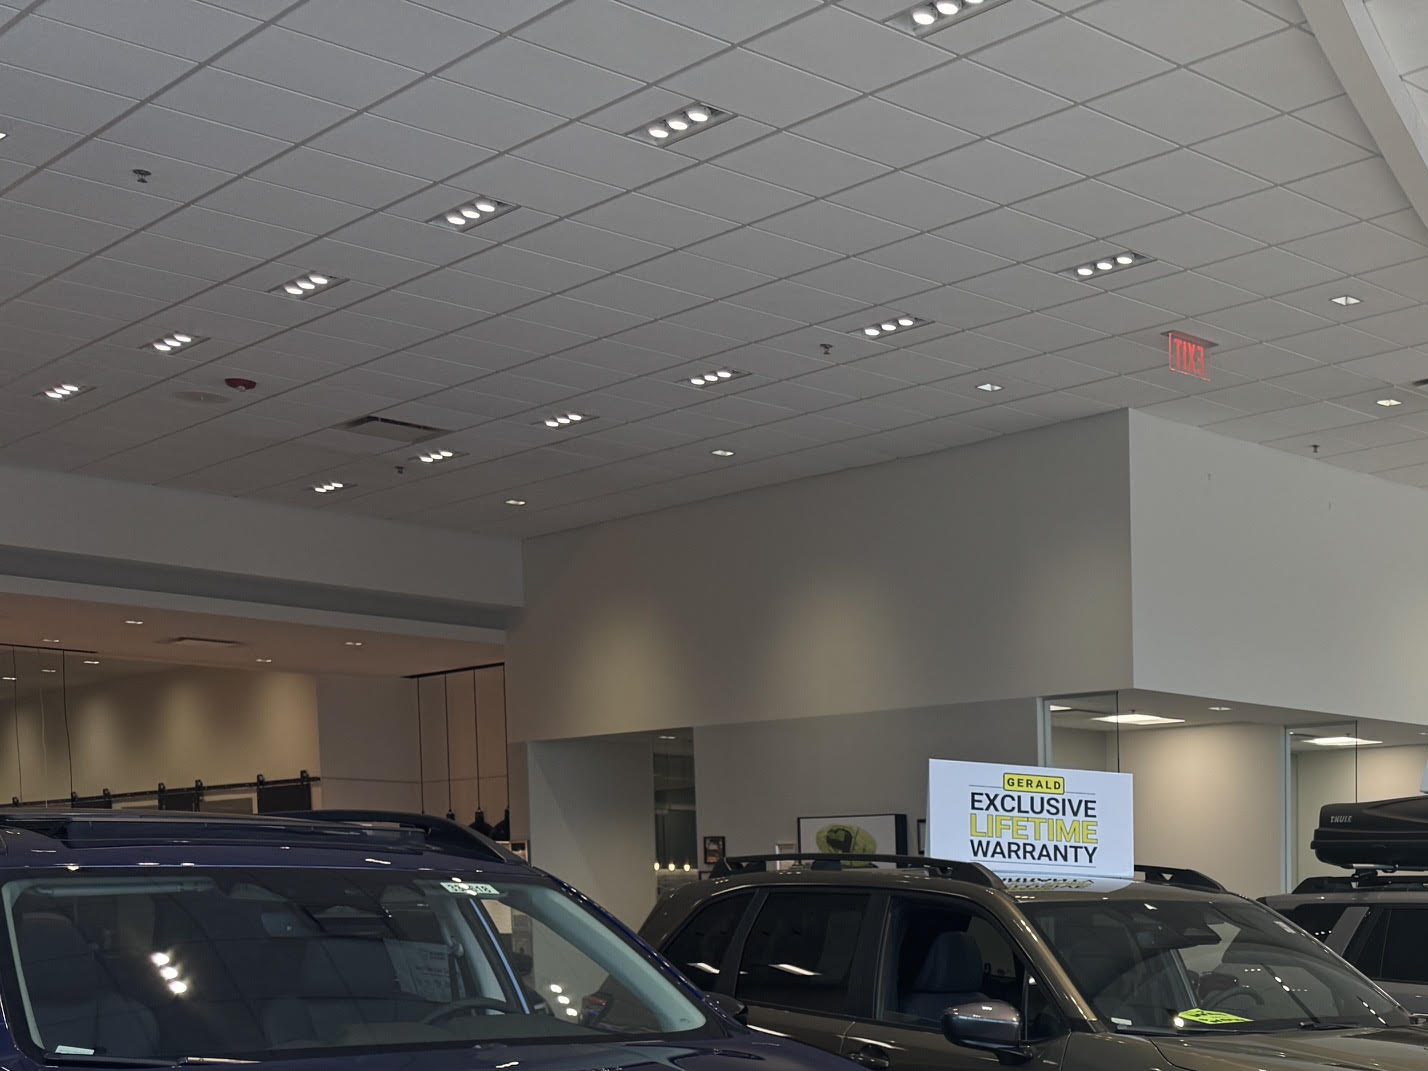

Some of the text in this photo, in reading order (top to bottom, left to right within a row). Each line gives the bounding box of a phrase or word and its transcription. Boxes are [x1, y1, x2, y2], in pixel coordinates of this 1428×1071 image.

[1007, 778, 1061, 790] GERALD
[970, 792, 1097, 818] EXCLUSIVE
[970, 813, 1098, 844] LIFETIME
[970, 840, 1098, 864] WARRANTY
